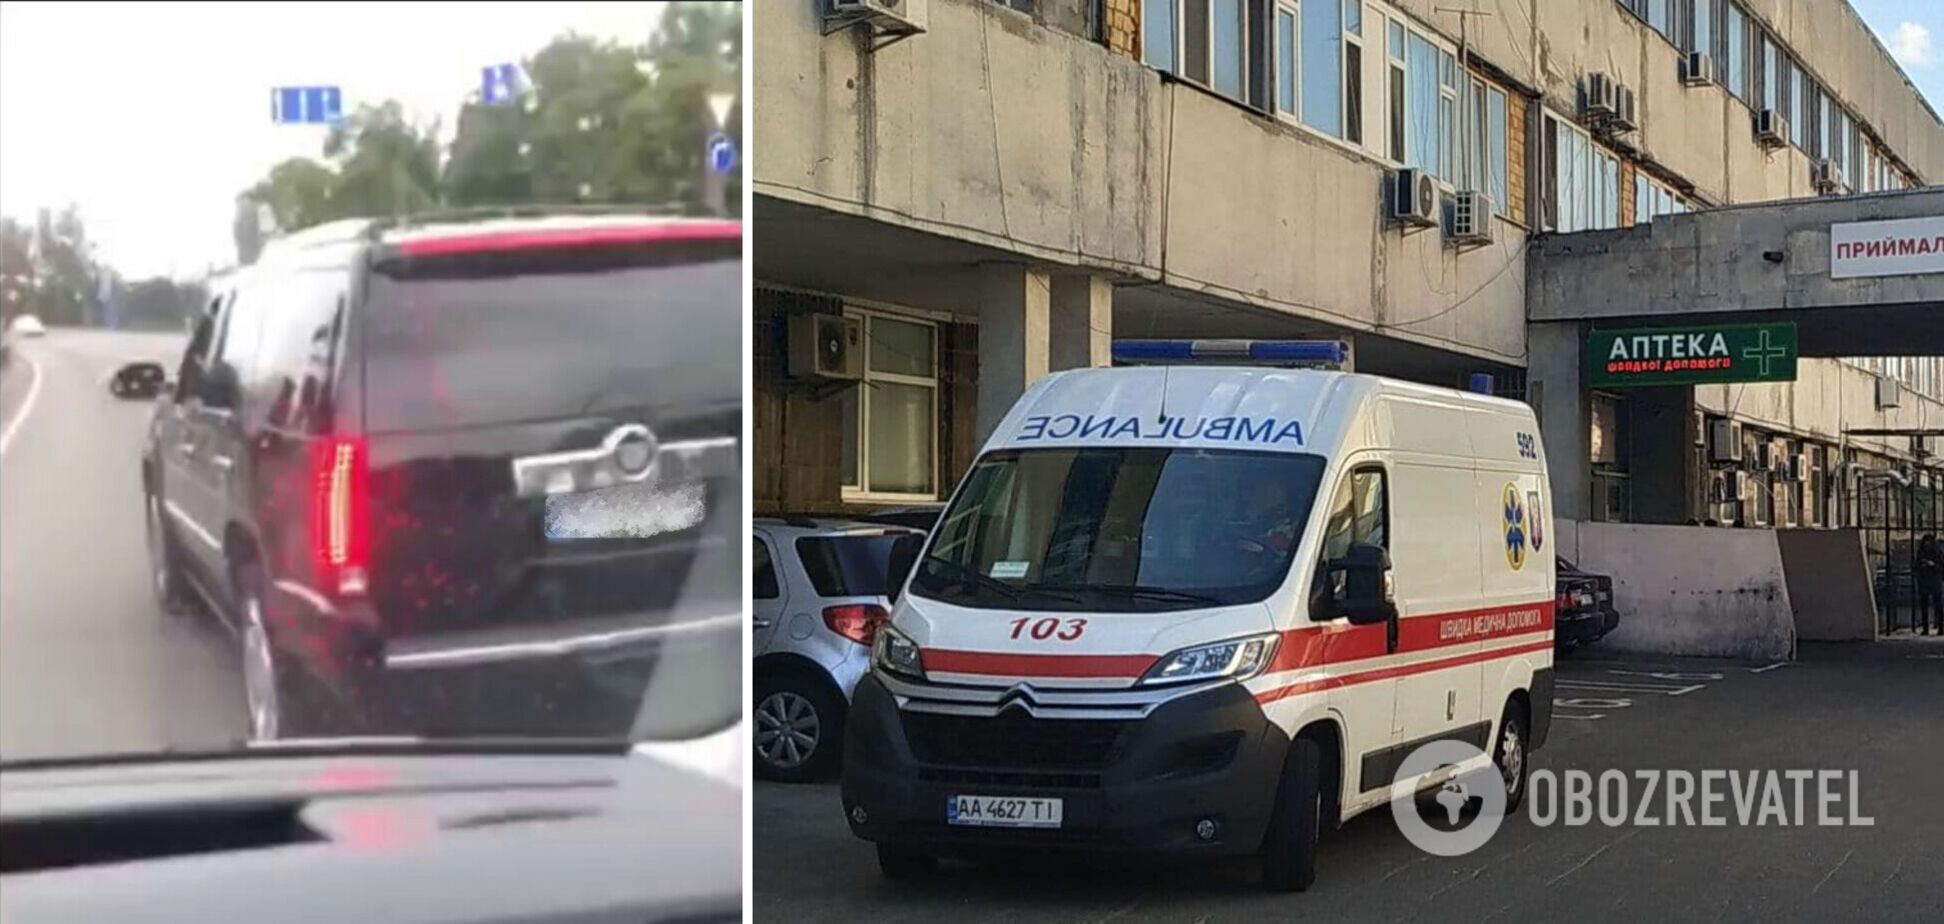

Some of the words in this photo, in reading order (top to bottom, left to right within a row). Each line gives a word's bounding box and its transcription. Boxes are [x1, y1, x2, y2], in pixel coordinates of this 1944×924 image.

[1609, 332, 1729, 360] АПТЕКА
[1516, 431, 1536, 459] 592
[1010, 617, 1088, 641] 103
[1441, 618, 1472, 640] ШВИДКА
[1507, 609, 1541, 631] ДОПОМОГА
[958, 798, 982, 817] AA
[986, 800, 1026, 820] 4627
